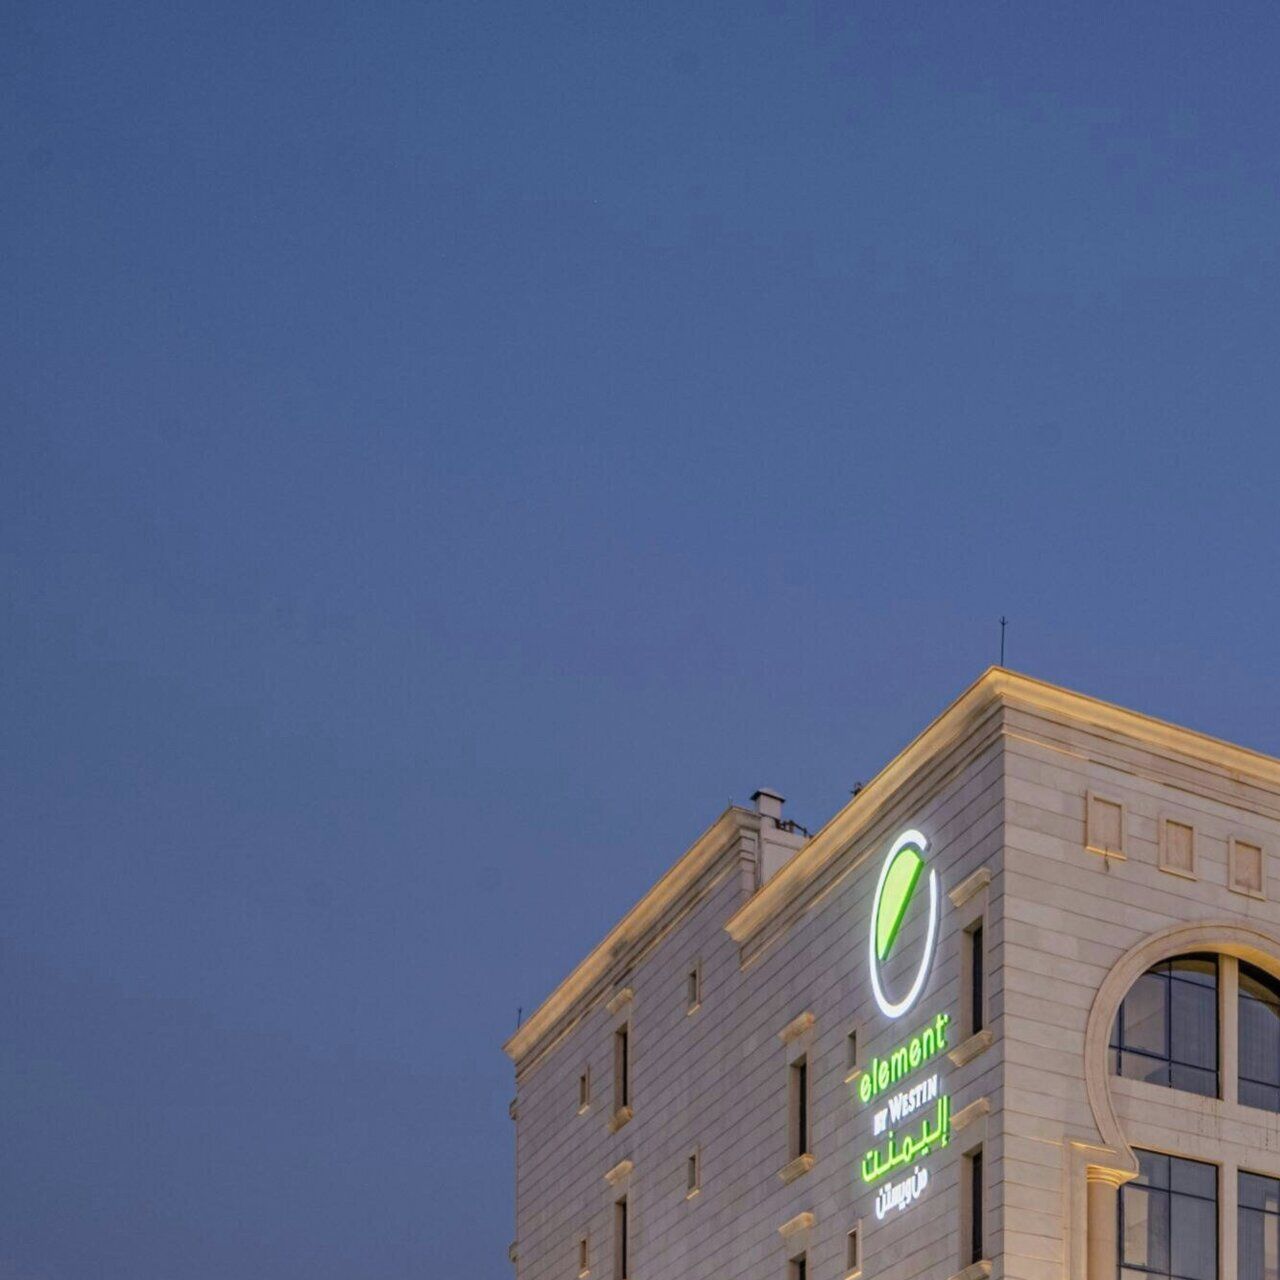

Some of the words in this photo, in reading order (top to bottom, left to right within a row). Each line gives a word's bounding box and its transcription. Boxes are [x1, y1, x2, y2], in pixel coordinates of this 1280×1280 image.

[860, 1014, 948, 1102] element
[862, 1095, 950, 1183] إليمنت
[874, 1108, 888, 1136] BY
